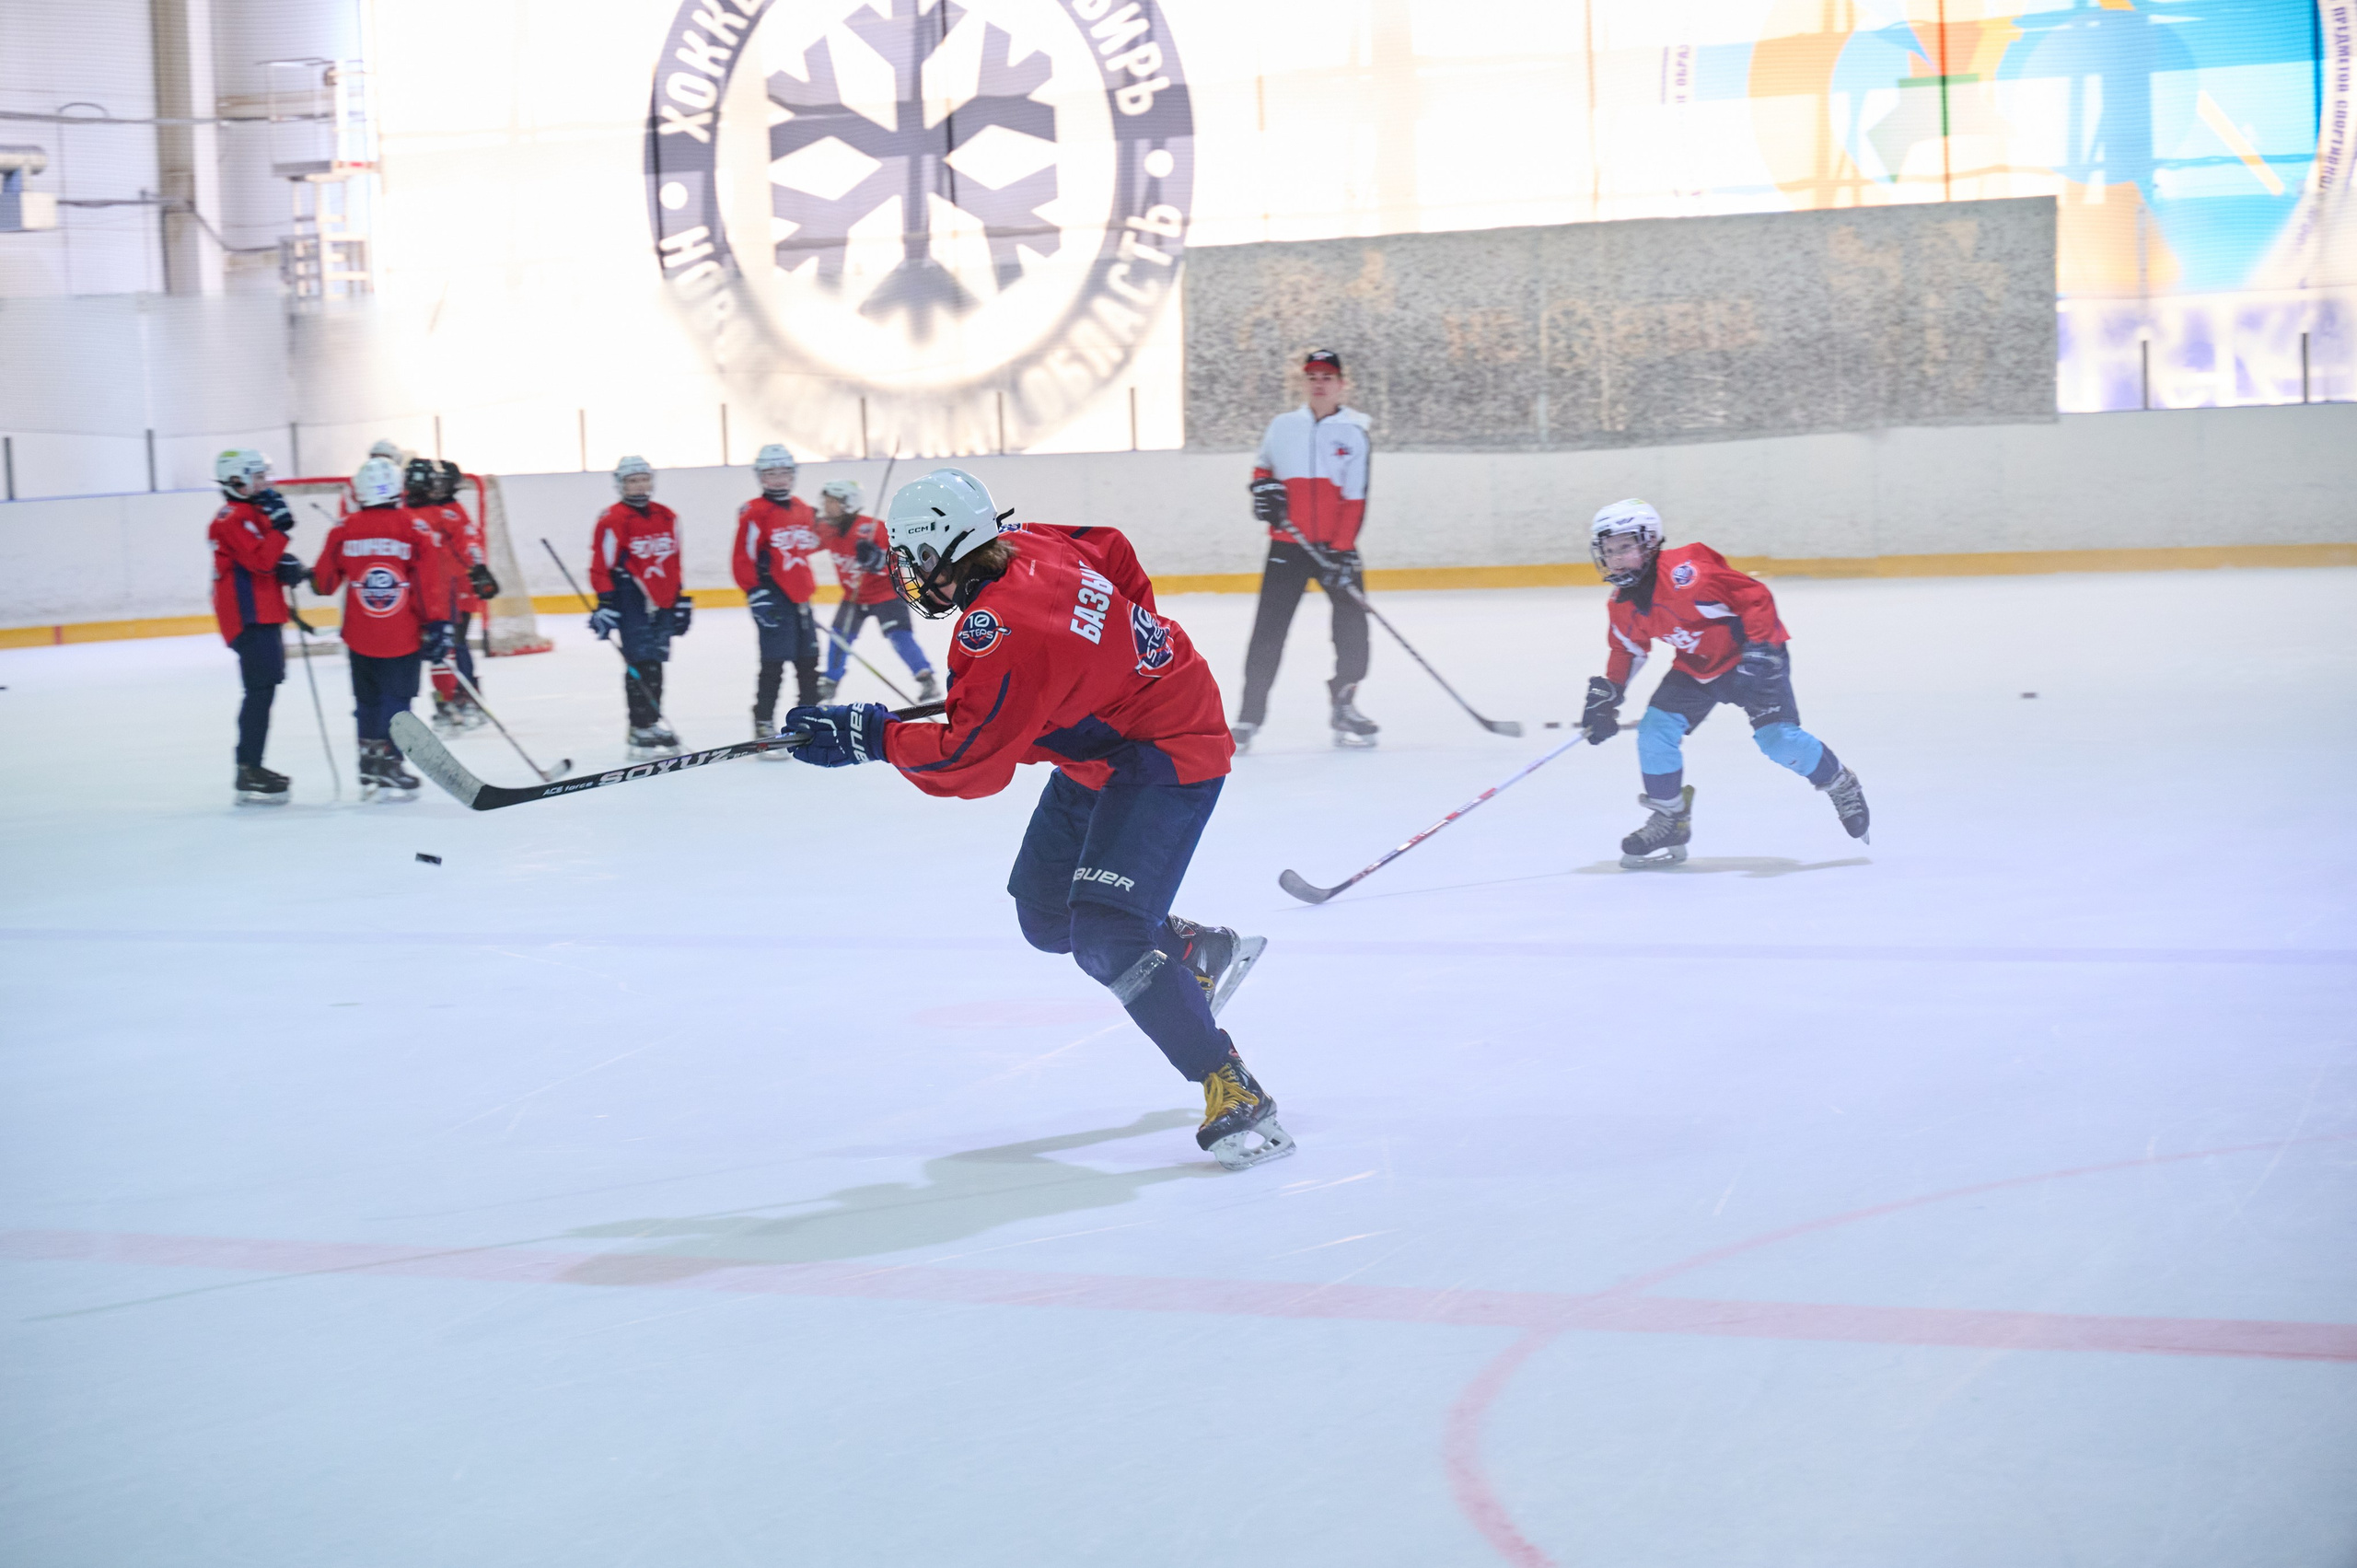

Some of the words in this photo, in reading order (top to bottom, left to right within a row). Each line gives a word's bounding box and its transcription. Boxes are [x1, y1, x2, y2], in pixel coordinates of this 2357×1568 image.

[657, 0, 766, 144] ХОКК
[908, 526, 929, 534] CCM
[962, 628, 994, 640] STEPS
[969, 614, 991, 629] 10
[1146, 627, 1164, 663] STE
[598, 748, 733, 787] SOYUZ
[1073, 866, 1135, 892] AUER
